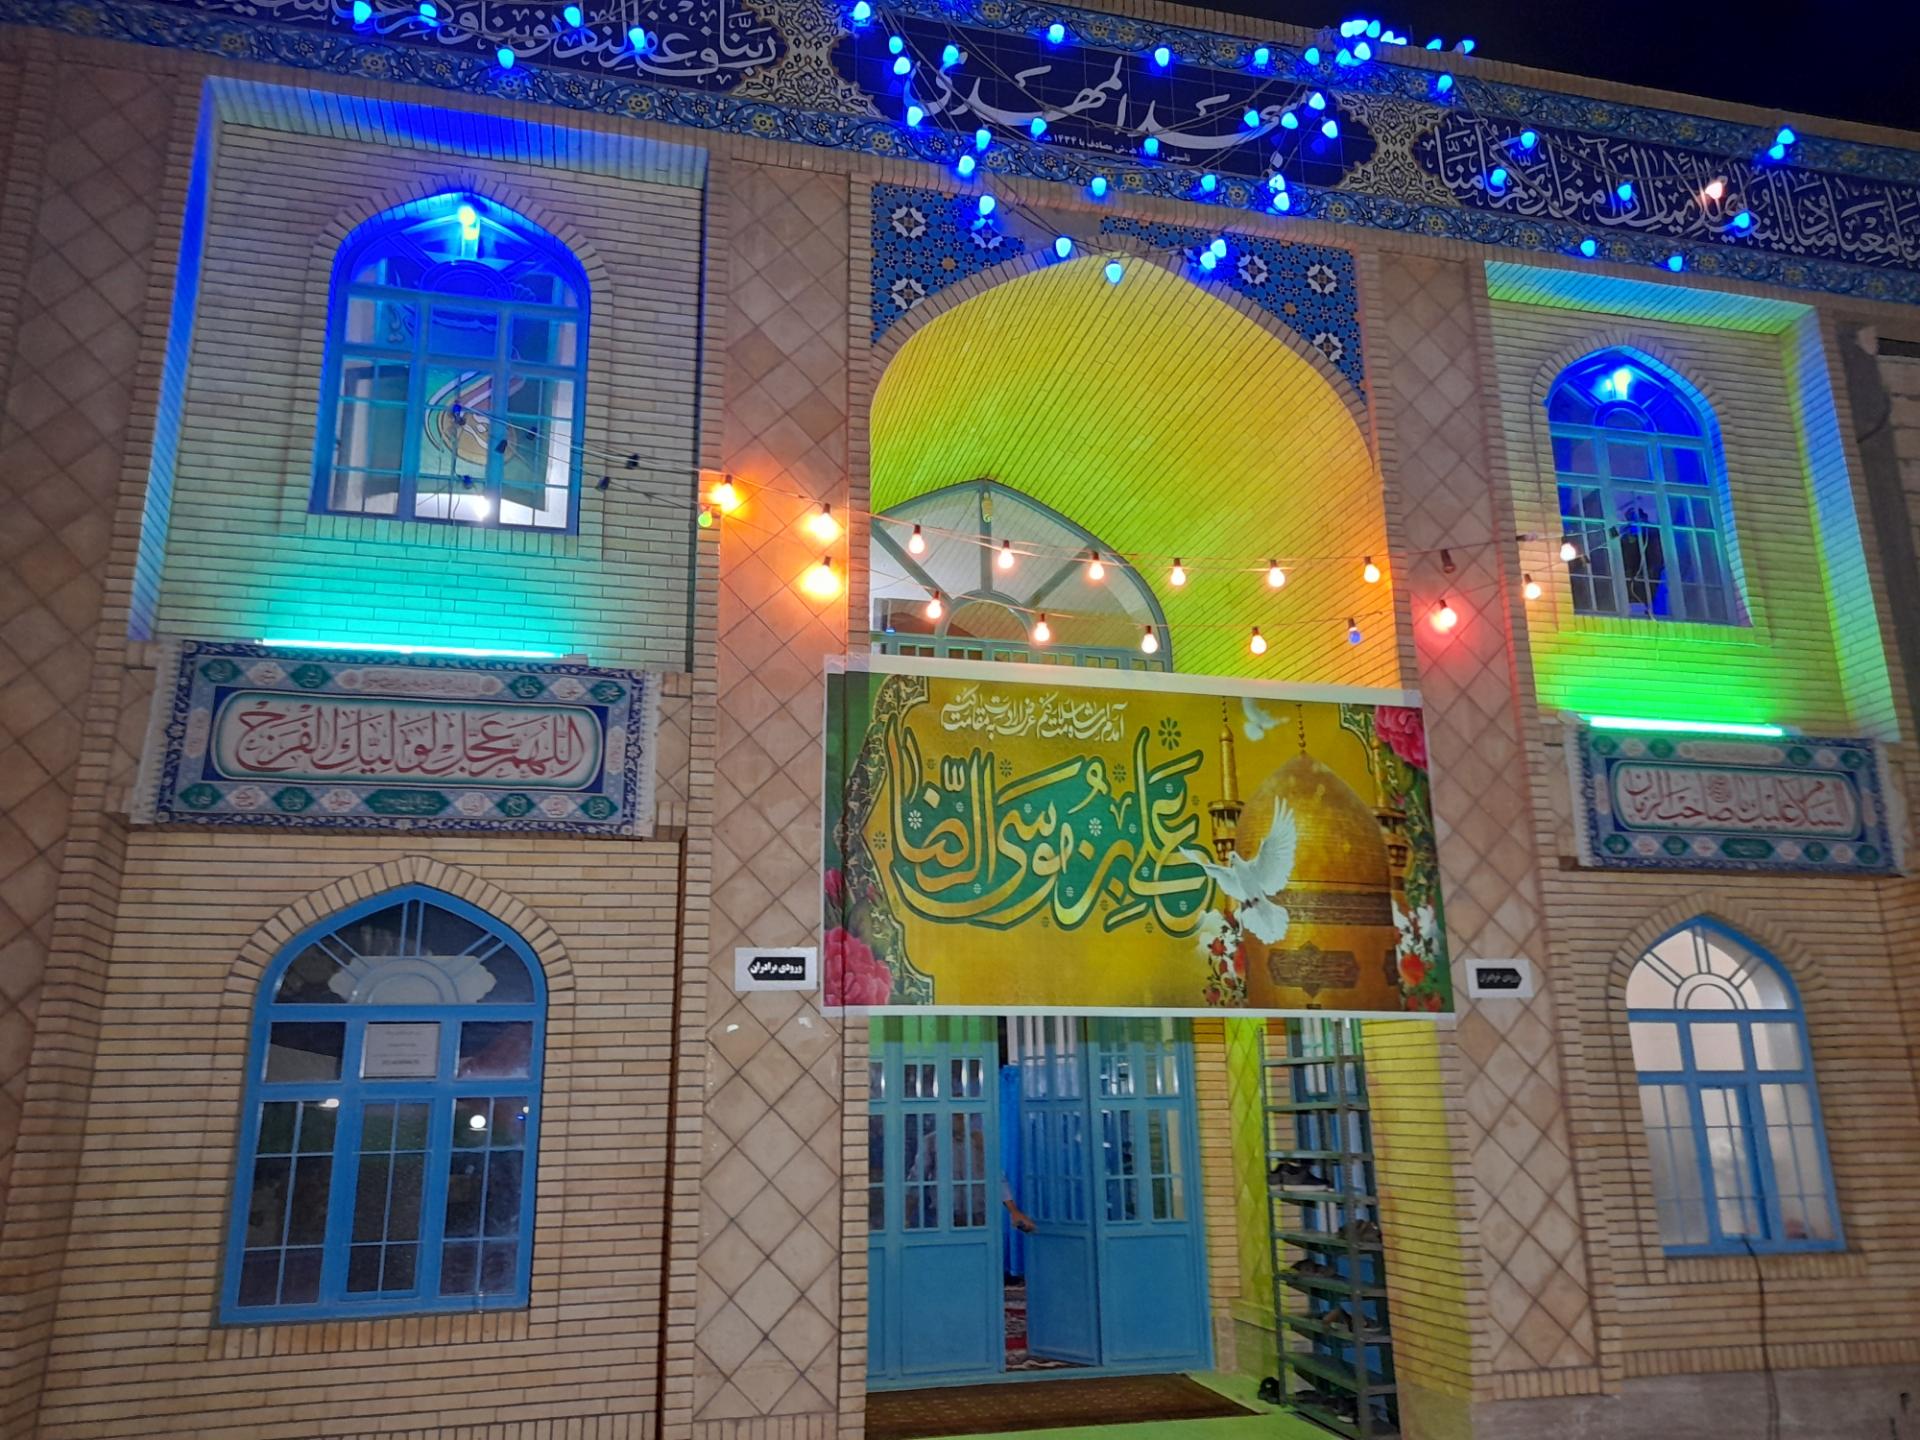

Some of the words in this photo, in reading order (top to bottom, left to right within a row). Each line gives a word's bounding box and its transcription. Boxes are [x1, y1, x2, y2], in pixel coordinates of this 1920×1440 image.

[904, 56, 1130, 136] المهدی
[1124, 92, 1318, 150] مسجد
[750, 961, 778, 975] برادران
[778, 963, 803, 975] ورودی
